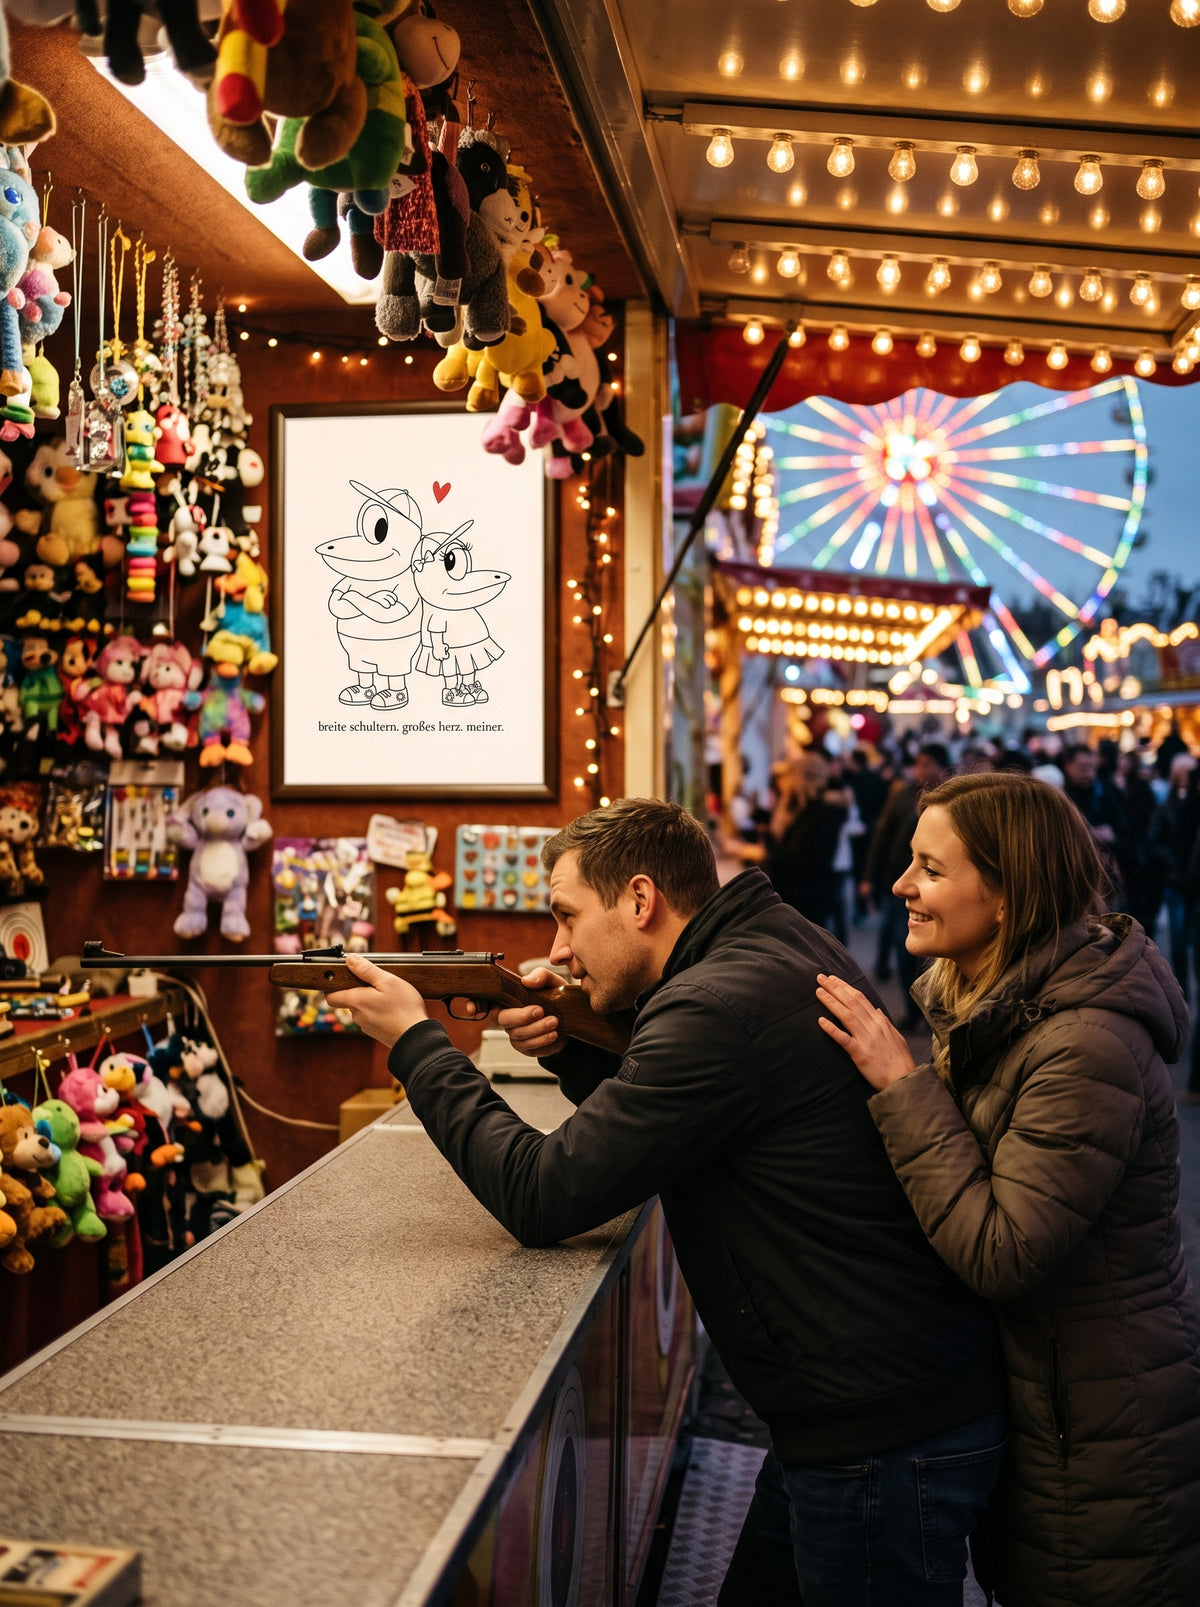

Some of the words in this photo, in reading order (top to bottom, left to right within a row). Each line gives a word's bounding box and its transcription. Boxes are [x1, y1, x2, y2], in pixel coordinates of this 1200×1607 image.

[318, 720, 347, 732] breite
[349, 720, 399, 732] schultern.
[402, 720, 436, 735] großes
[438, 720, 463, 732] herz.
[466, 721, 504, 732] meiner.
